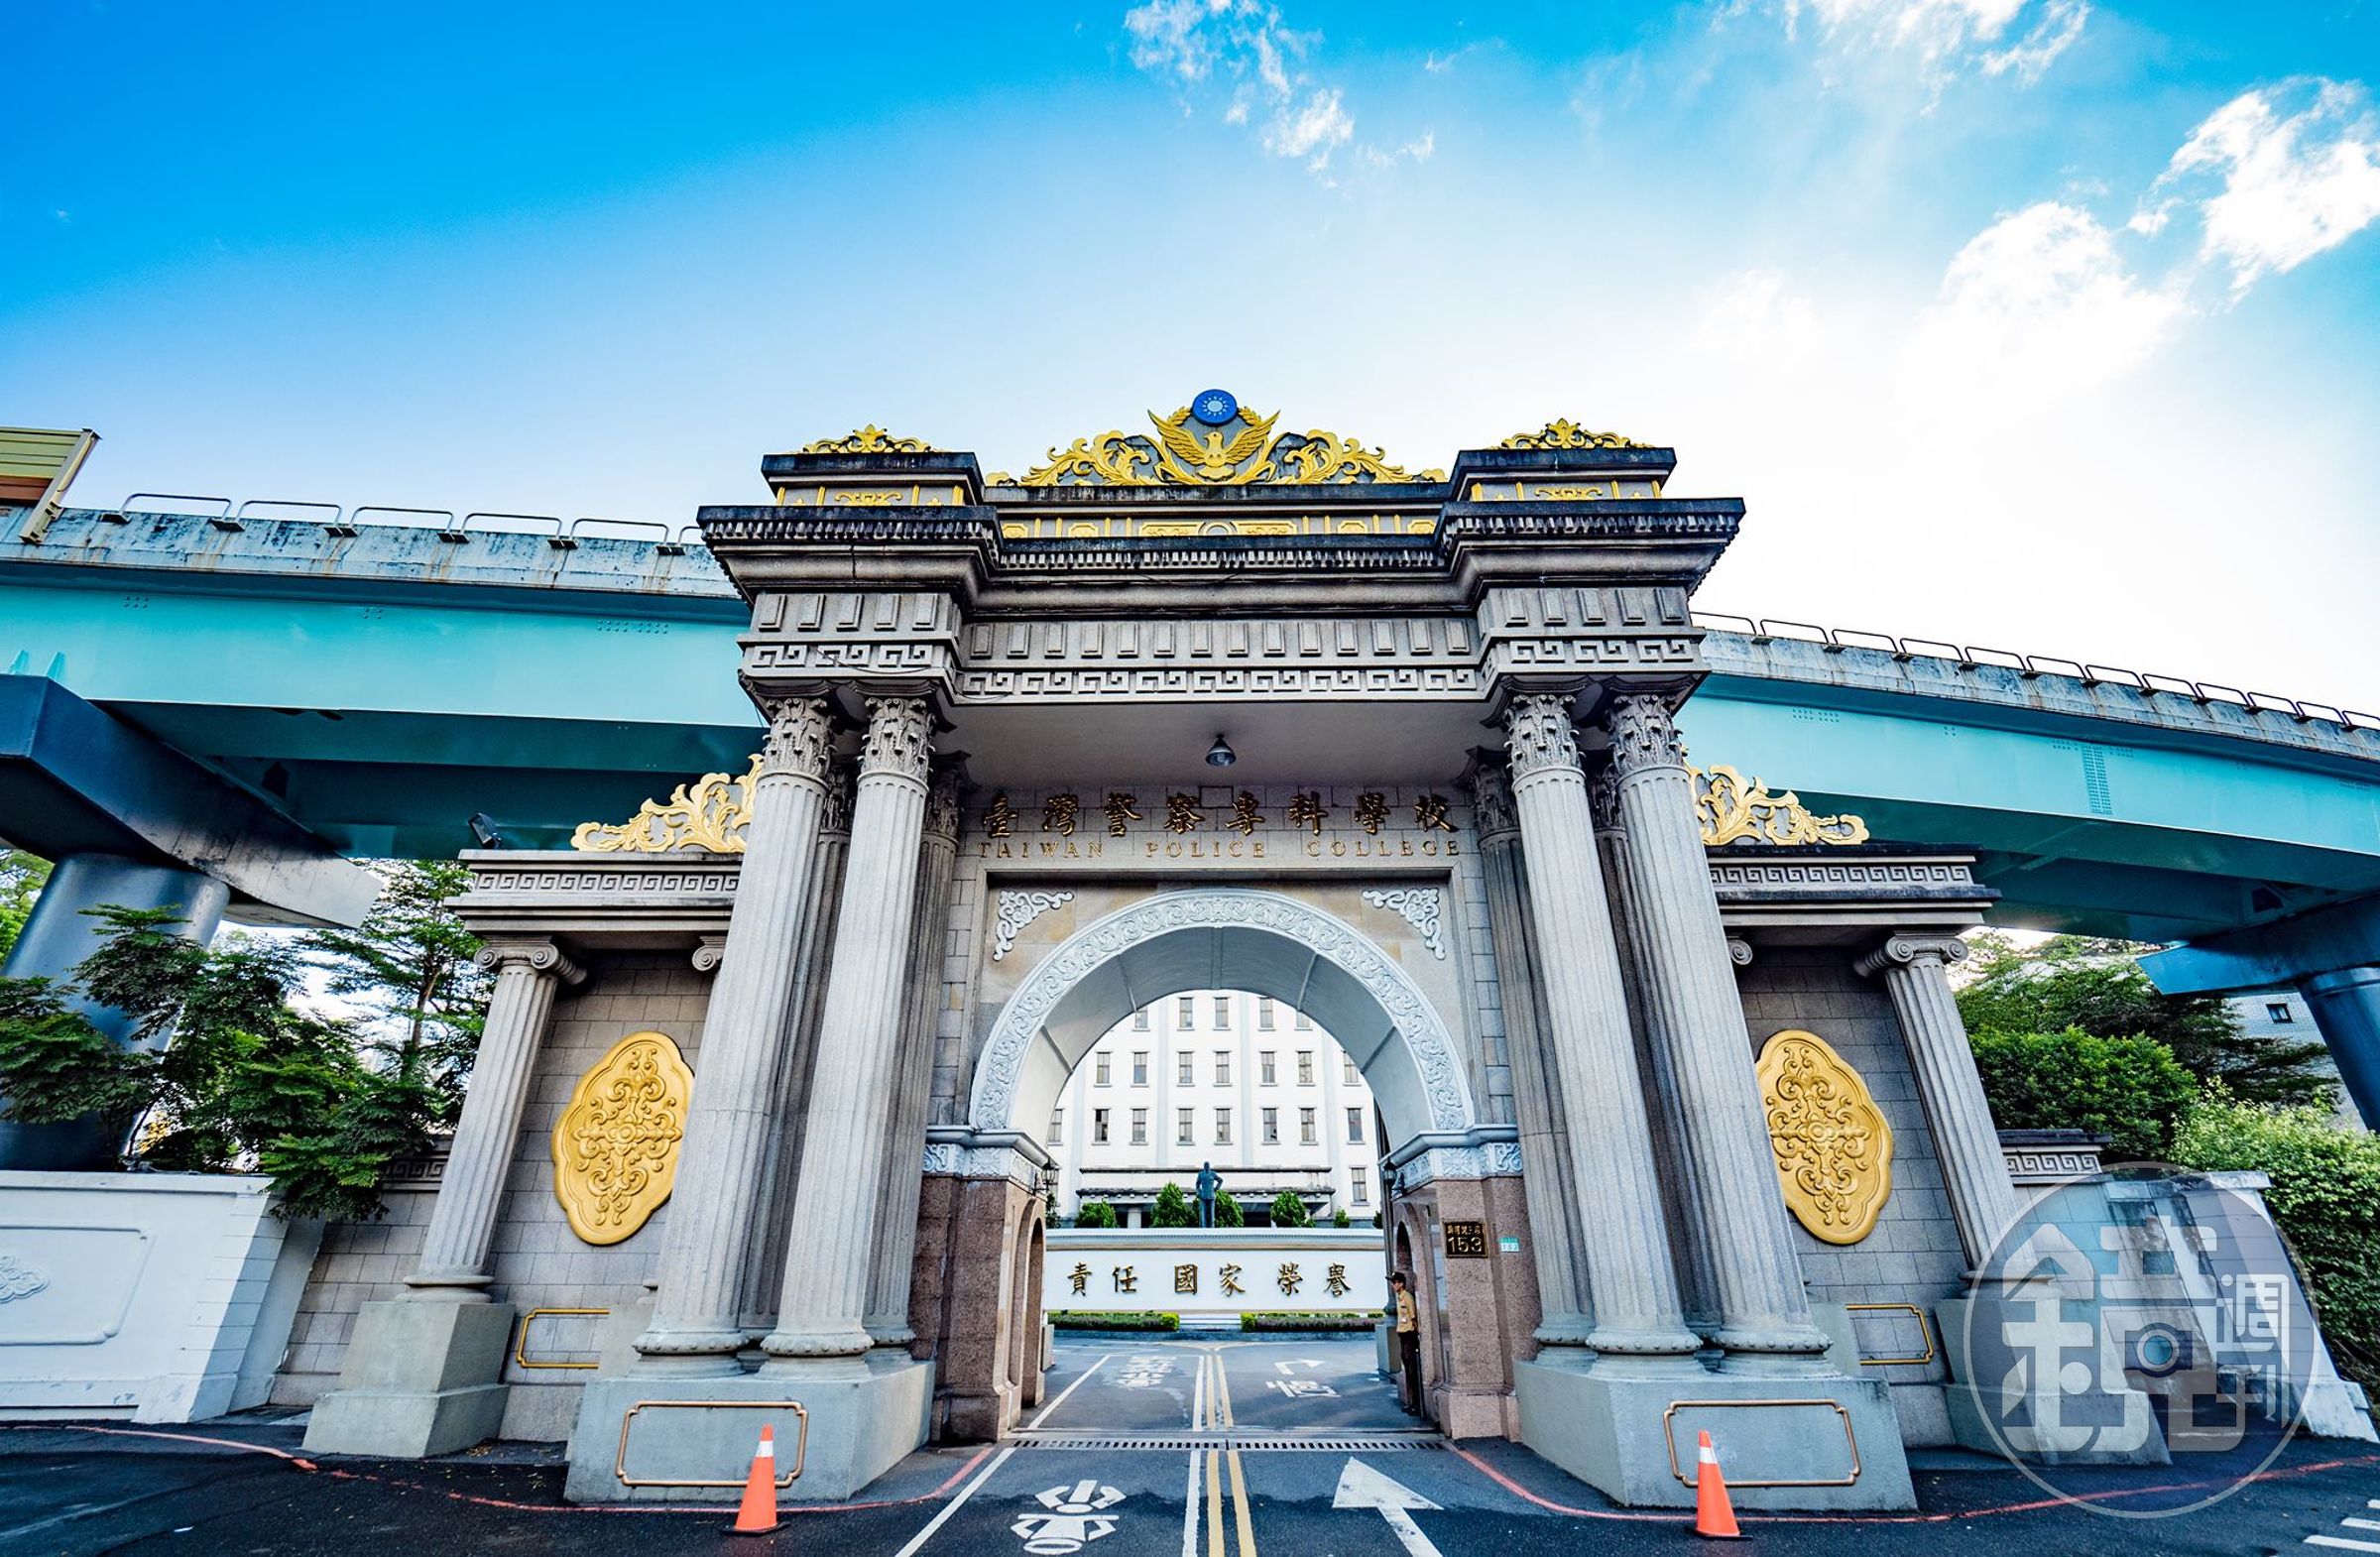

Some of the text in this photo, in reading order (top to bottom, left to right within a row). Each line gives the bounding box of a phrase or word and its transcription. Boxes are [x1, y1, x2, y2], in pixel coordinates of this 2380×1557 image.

[982, 791, 1460, 839] 臺灣警察專科學校
[978, 840, 1461, 859] TAIWAN POLICE COLLEGE
[1448, 1237, 1483, 1253] 153
[1067, 1261, 1353, 1297] 責任國家榮譽
